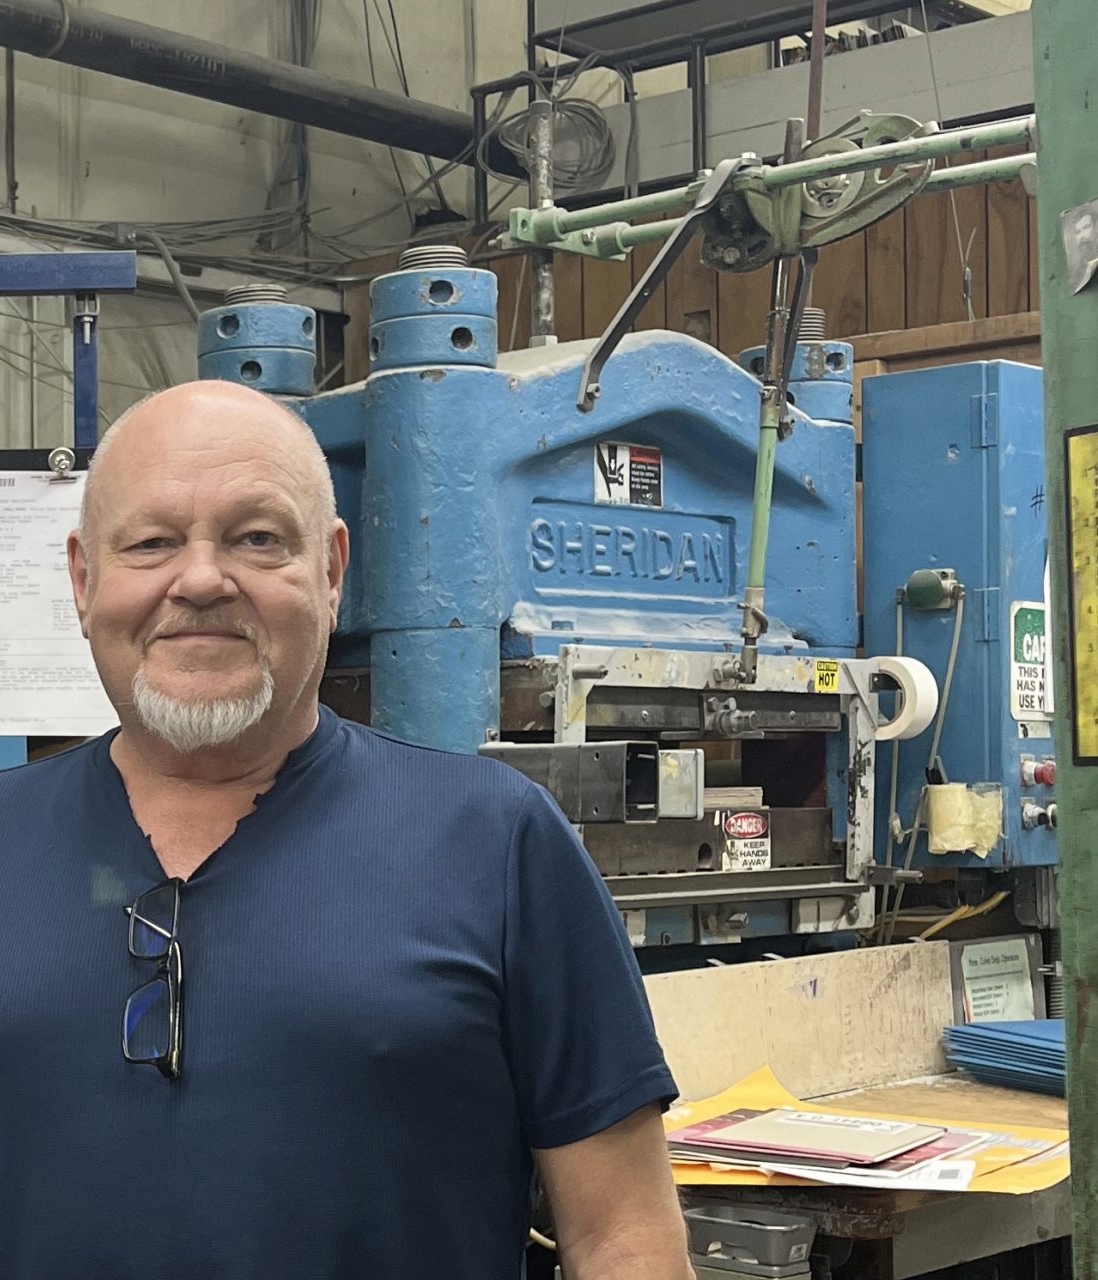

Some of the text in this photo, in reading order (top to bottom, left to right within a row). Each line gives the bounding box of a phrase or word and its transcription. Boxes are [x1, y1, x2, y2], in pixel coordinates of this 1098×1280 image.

[530, 517, 724, 583] SHERIDAN
[1018, 666, 1039, 678] THIS
[818, 672, 835, 686] HOT
[1017, 680, 1036, 691] HAS
[1019, 695, 1034, 708] USE
[730, 817, 763, 833] DANGER
[743, 841, 765, 849] KEEP
[740, 849, 769, 857] HANDS
[742, 858, 766, 867] AWAY
